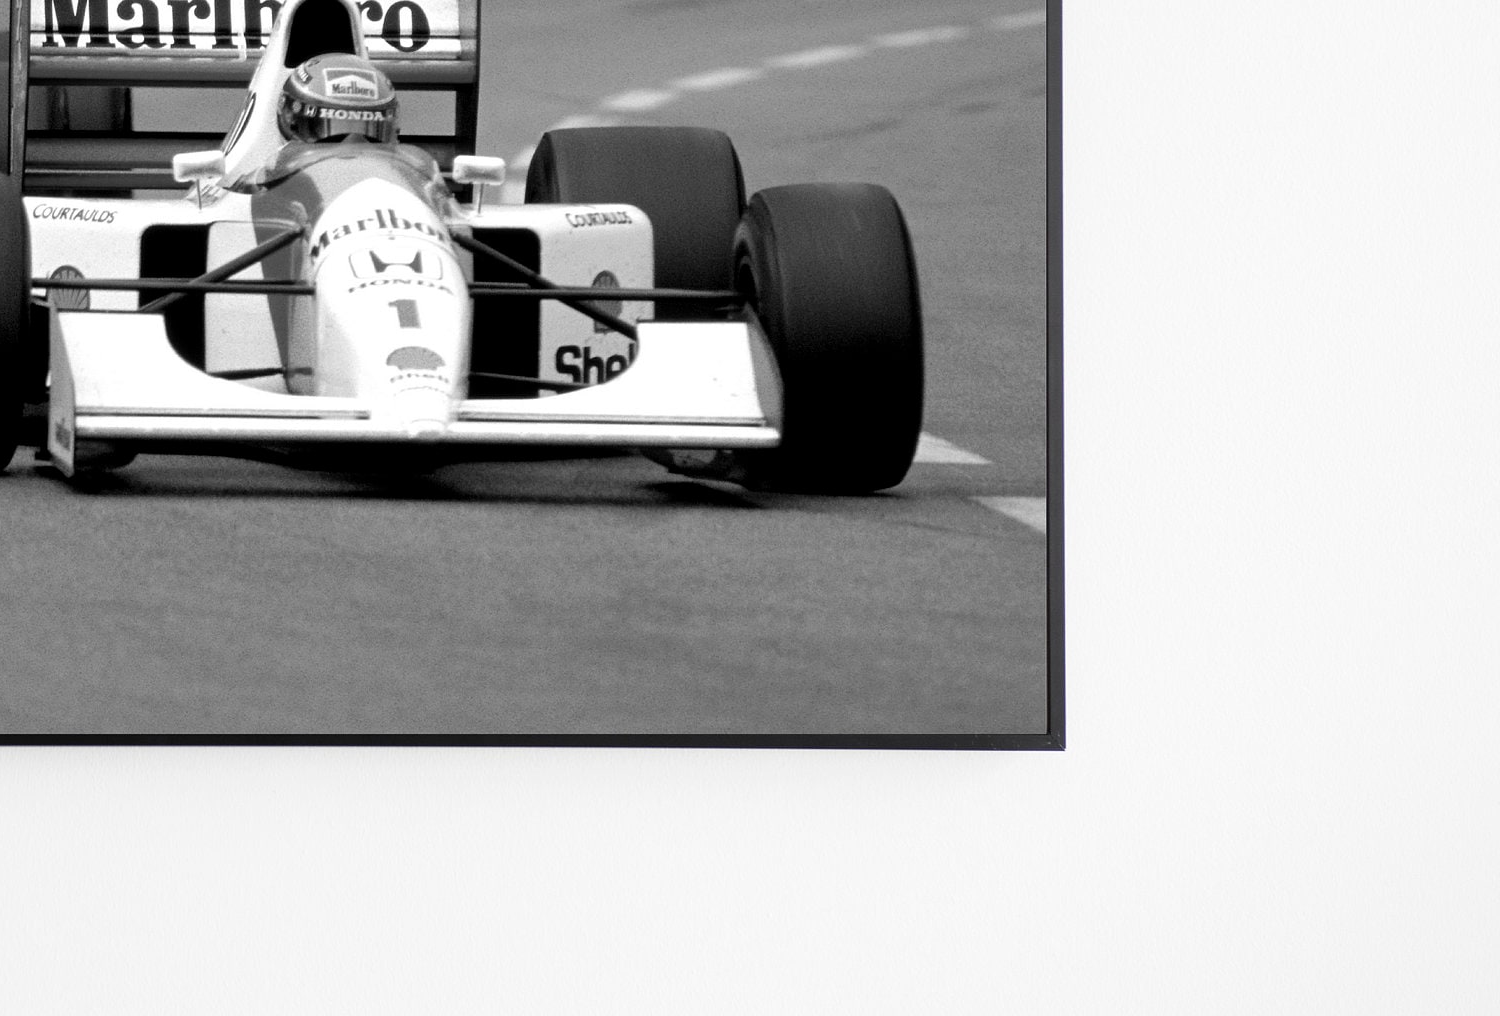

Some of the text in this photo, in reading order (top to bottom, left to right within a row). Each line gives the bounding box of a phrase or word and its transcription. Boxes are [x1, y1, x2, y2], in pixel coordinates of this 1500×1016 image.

[332, 80, 377, 97] Marlboro
[319, 107, 385, 121] HONDA
[32, 203, 119, 224] COURTAULDS
[564, 210, 633, 228] COURTAULDS
[348, 278, 455, 296] HONDA
[388, 299, 422, 329] 1
